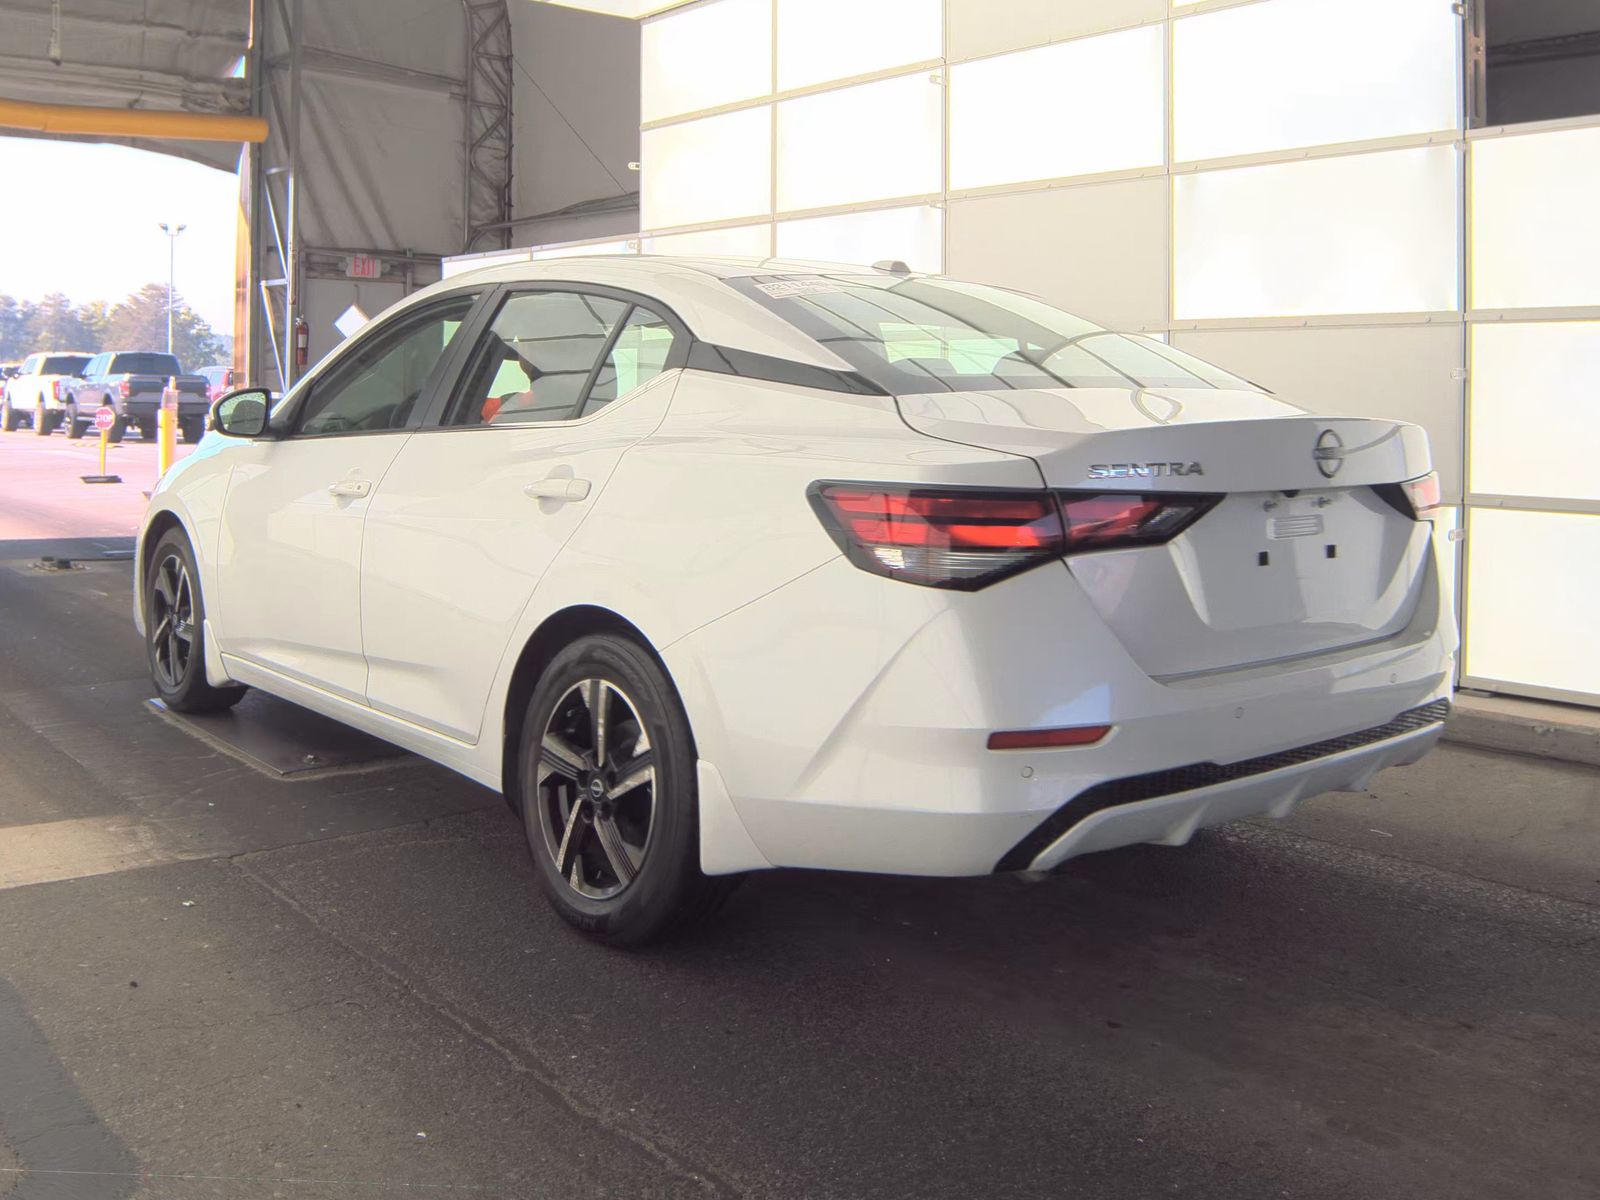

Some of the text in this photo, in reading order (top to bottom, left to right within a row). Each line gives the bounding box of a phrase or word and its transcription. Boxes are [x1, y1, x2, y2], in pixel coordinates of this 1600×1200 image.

[353, 256, 377, 275] EXIT
[96, 414, 113, 423] STOP
[1087, 462, 1204, 479] SENTRA
